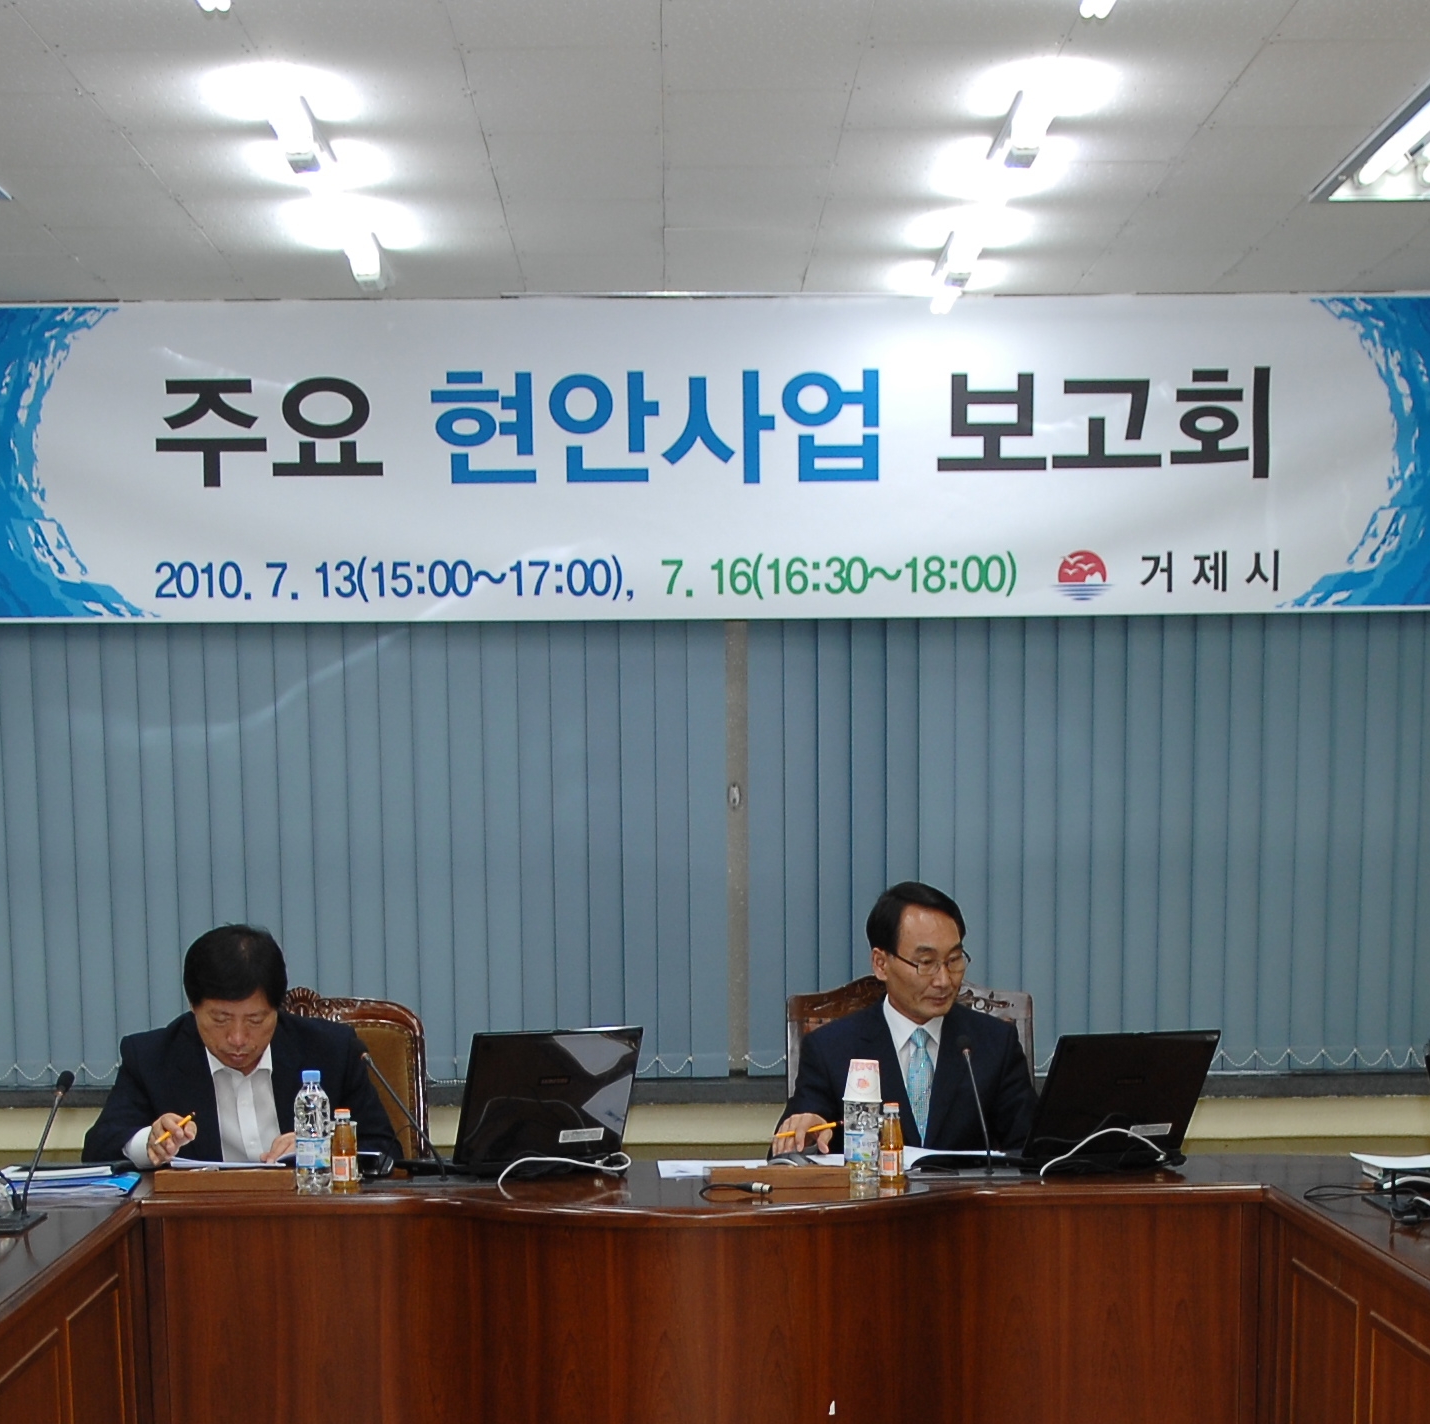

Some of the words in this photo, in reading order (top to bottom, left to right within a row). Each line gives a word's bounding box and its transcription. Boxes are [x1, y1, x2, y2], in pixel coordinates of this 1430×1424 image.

[155, 376, 384, 488] 주요
[430, 369, 879, 484] 현안사업
[937, 366, 1271, 479] 보고회
[155, 560, 252, 600] 2010.
[265, 562, 299, 600] 7.
[661, 559, 693, 597] 7.
[711, 551, 1017, 600] 16(16:30~18:00)
